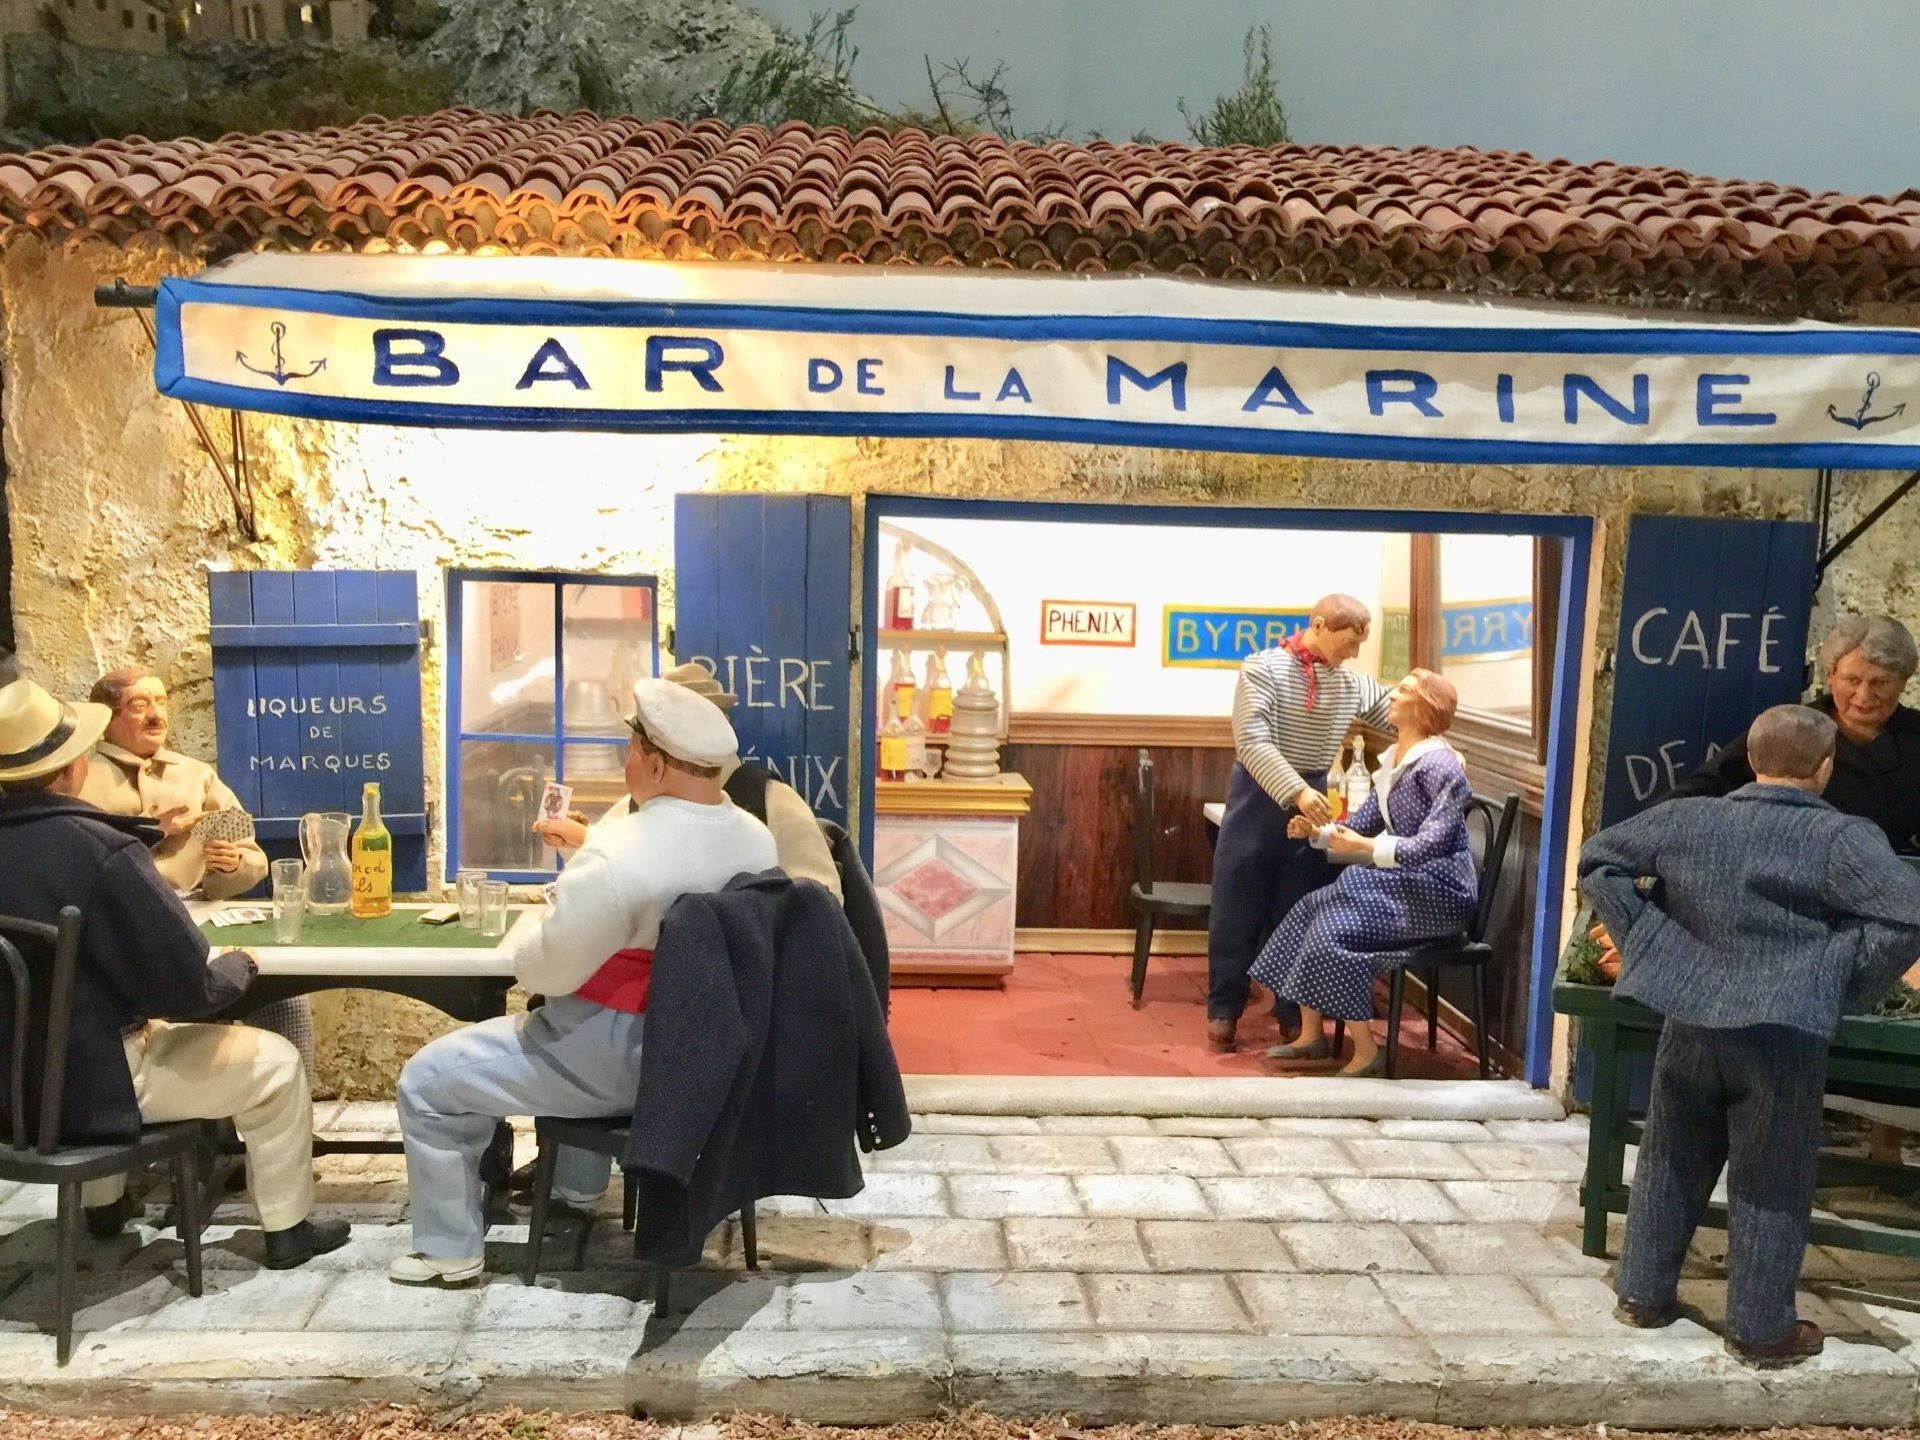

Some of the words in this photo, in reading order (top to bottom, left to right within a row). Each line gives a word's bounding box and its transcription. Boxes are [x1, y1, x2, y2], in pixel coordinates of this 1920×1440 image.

[373, 328, 724, 393] BAR
[808, 357, 886, 396] DE
[944, 364, 1033, 403] LA
[1106, 354, 1777, 426] MARINE
[1048, 609, 1125, 635] PHENIX
[1176, 618, 1300, 655] BYRR
[1632, 605, 1787, 674] CAFÉ
[247, 694, 388, 719] LIQUEURS
[309, 725, 334, 739] DE
[250, 752, 392, 774] MARQUES
[741, 744, 844, 810] NIX
